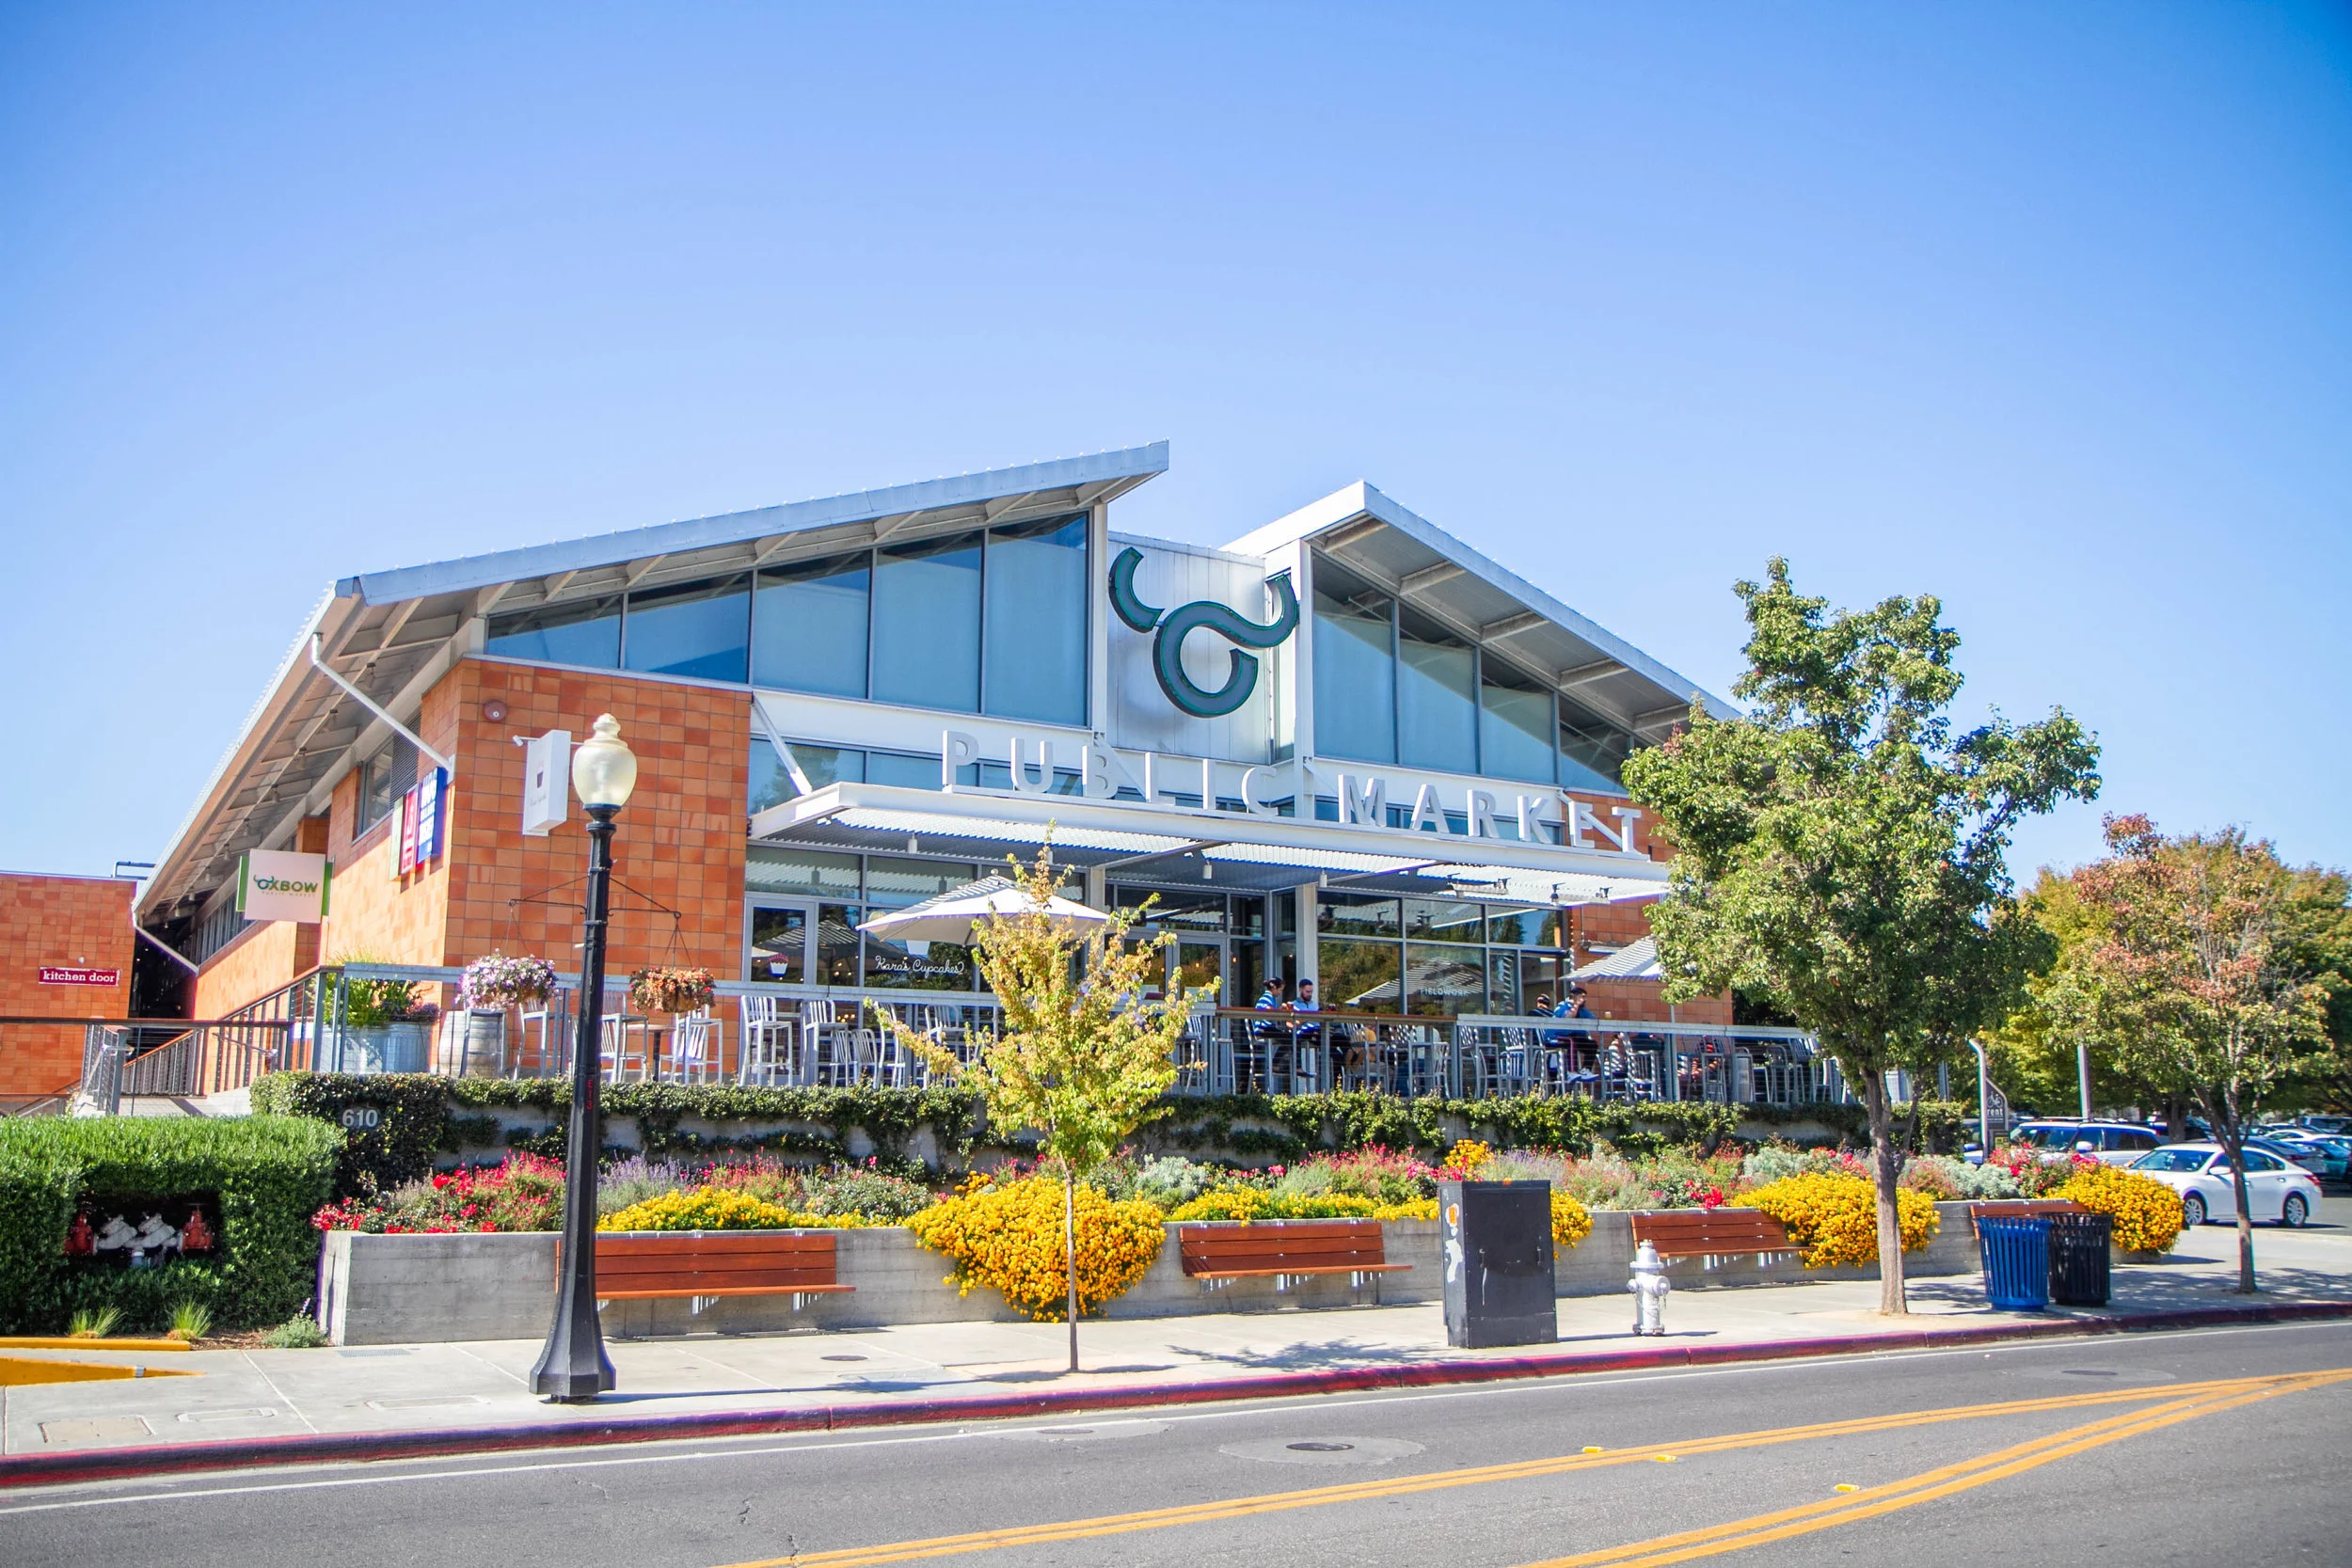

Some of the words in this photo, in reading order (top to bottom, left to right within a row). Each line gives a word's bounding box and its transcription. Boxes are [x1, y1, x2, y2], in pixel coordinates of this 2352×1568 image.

[942, 730, 1279, 816] PUBLIC
[1338, 774, 1642, 852] MARKET
[253, 874, 318, 893] OXBOW
[875, 955, 911, 971] Kara's
[912, 958, 965, 978] Cupcakes
[43, 971, 87, 982] kitchen
[88, 973, 116, 983] door
[1420, 988, 1469, 998] FIELDWORK
[342, 1109, 378, 1127] 610
[1987, 1108, 2004, 1117] rent
